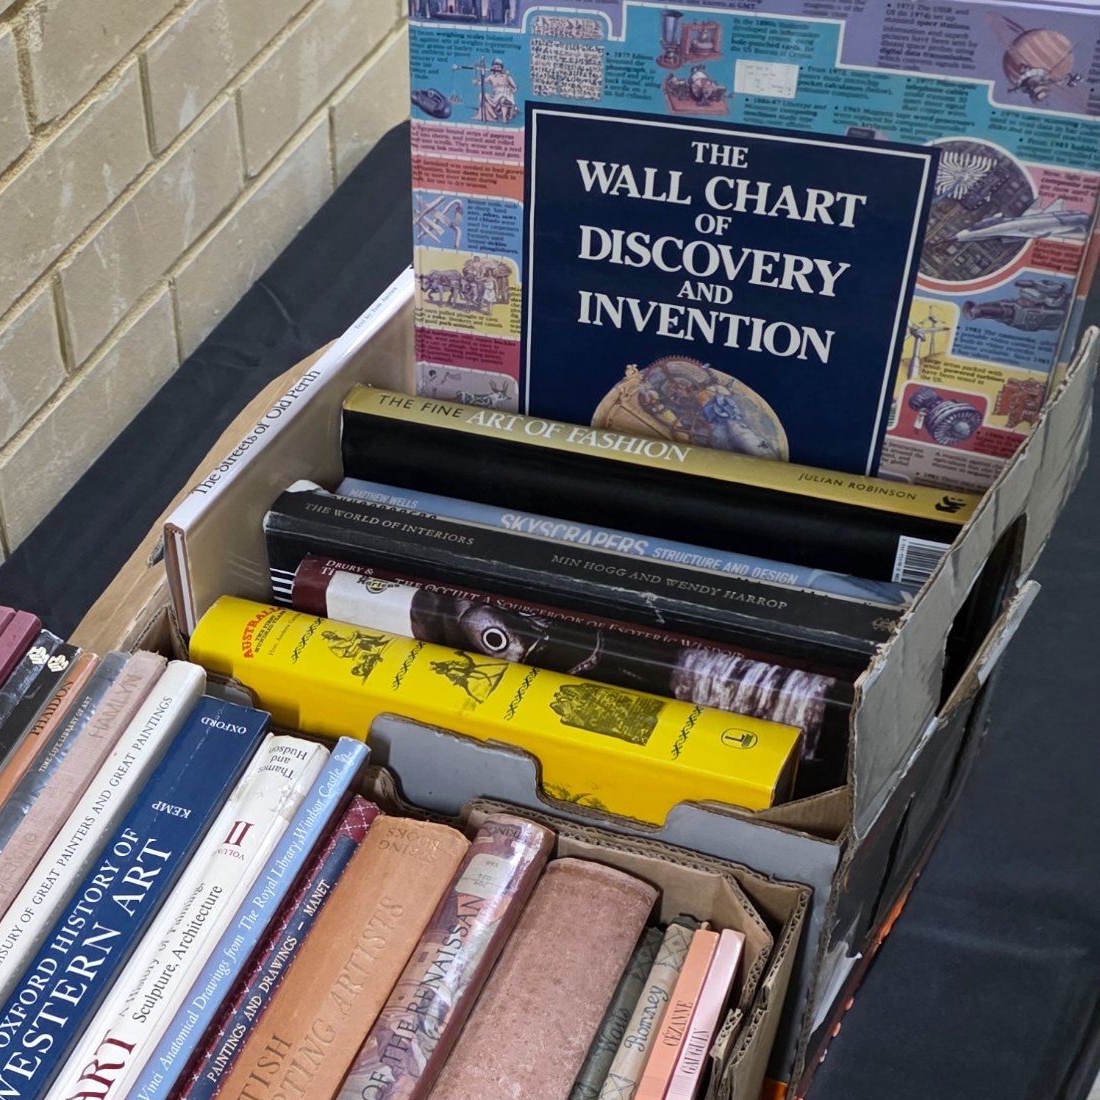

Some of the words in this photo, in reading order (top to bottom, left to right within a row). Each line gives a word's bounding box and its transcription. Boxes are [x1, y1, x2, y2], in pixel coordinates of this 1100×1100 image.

[691, 141, 749, 168] THE
[576, 159, 692, 205] WALL
[704, 175, 867, 228] CHART
[694, 213, 732, 235] OF
[577, 224, 851, 297] DISCOVERY
[677, 281, 733, 305] AND
[576, 290, 836, 364] INVENTION
[215, 433, 258, 475] Streets
[378, 394, 413, 410] THE
[420, 401, 464, 419] FINE
[466, 410, 518, 432] ART
[524, 420, 563, 439] OF
[566, 427, 692, 463] FASHION
[349, 488, 388, 504] MATTHEW
[798, 472, 843, 487] JULIAN
[848, 480, 917, 501] ROBINSON
[304, 502, 330, 515] THE
[334, 509, 380, 526] WORLD
[400, 523, 475, 546] INTERIORS
[500, 513, 650, 556] SKYSCRAPERS
[551, 554, 574, 567] MIN
[578, 559, 626, 577] HOGG
[629, 569, 661, 584] AND
[666, 577, 721, 597] WENDY
[724, 590, 788, 609] HARROP
[653, 547, 722, 570] STRUCTURE
[722, 560, 750, 575] AND
[751, 565, 799, 585] DESIGN
[29, 680, 74, 737] PHAIDON
[59, 714, 80, 744] LIBRARY
[89, 673, 141, 740] HAMLYN
[200, 716, 247, 735] OXFORD
[268, 746, 307, 761] Hudson
[31, 866, 61, 908] GREAT
[56, 815, 96, 866] PAINTERS
[92, 789, 112, 815] AND
[109, 752, 137, 790] GREAT
[134, 695, 173, 753] PAINTINGS
[151, 801, 192, 819] KEMP
[222, 820, 255, 848] II
[50, 866, 118, 956] HISTORY
[113, 827, 139, 856] OF
[112, 838, 172, 917] ART
[160, 1012, 200, 1072] Anatomical
[197, 960, 229, 1011] Drawings
[253, 875, 277, 909] Royal
[294, 797, 323, 853] Windsor
[319, 769, 343, 801] Castle
[132, 961, 181, 1023] Sculpture,
[172, 885, 223, 959] Architecture
[331, 894, 407, 1020] ARTISTS
[206, 1022, 247, 1084] PAINTINGS
[243, 994, 262, 1023] AND
[258, 936, 298, 993] DRAWINGS
[303, 879, 330, 917] MANET
[377, 1008, 420, 1069] THE
[623, 984, 668, 1052] Romney
[661, 999, 694, 1048] CÉZANNE
[680, 1027, 710, 1075] GAUGUIN
